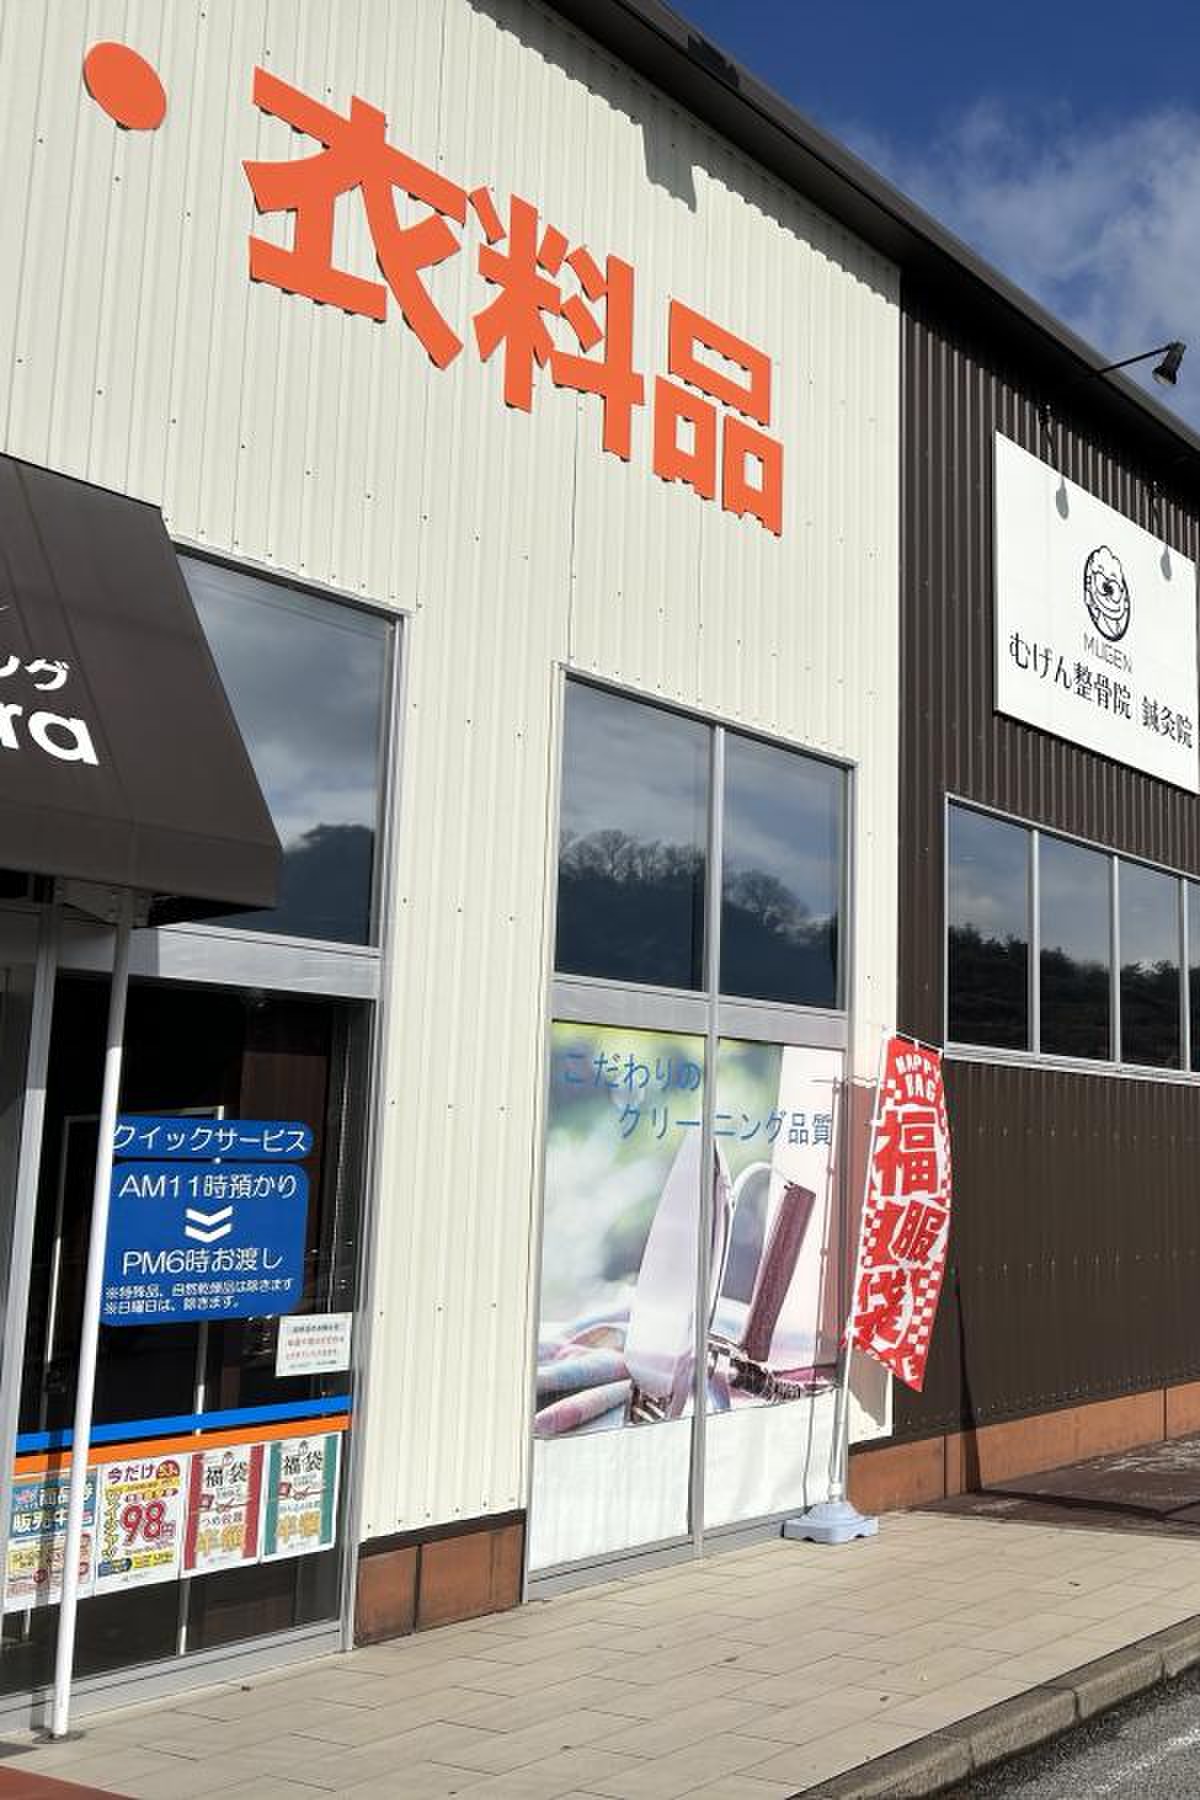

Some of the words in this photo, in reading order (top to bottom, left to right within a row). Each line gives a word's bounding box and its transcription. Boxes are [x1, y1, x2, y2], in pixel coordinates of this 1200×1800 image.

[1009, 632, 1132, 720] むげん整骨院
[563, 1051, 702, 1092] こだわりの
[112, 1124, 306, 1154] クイックサービス
[619, 1104, 834, 1147] クリーニング品質
[122, 1246, 284, 1277] PM6時お渡し
[107, 1463, 155, 1484] 今だけ
